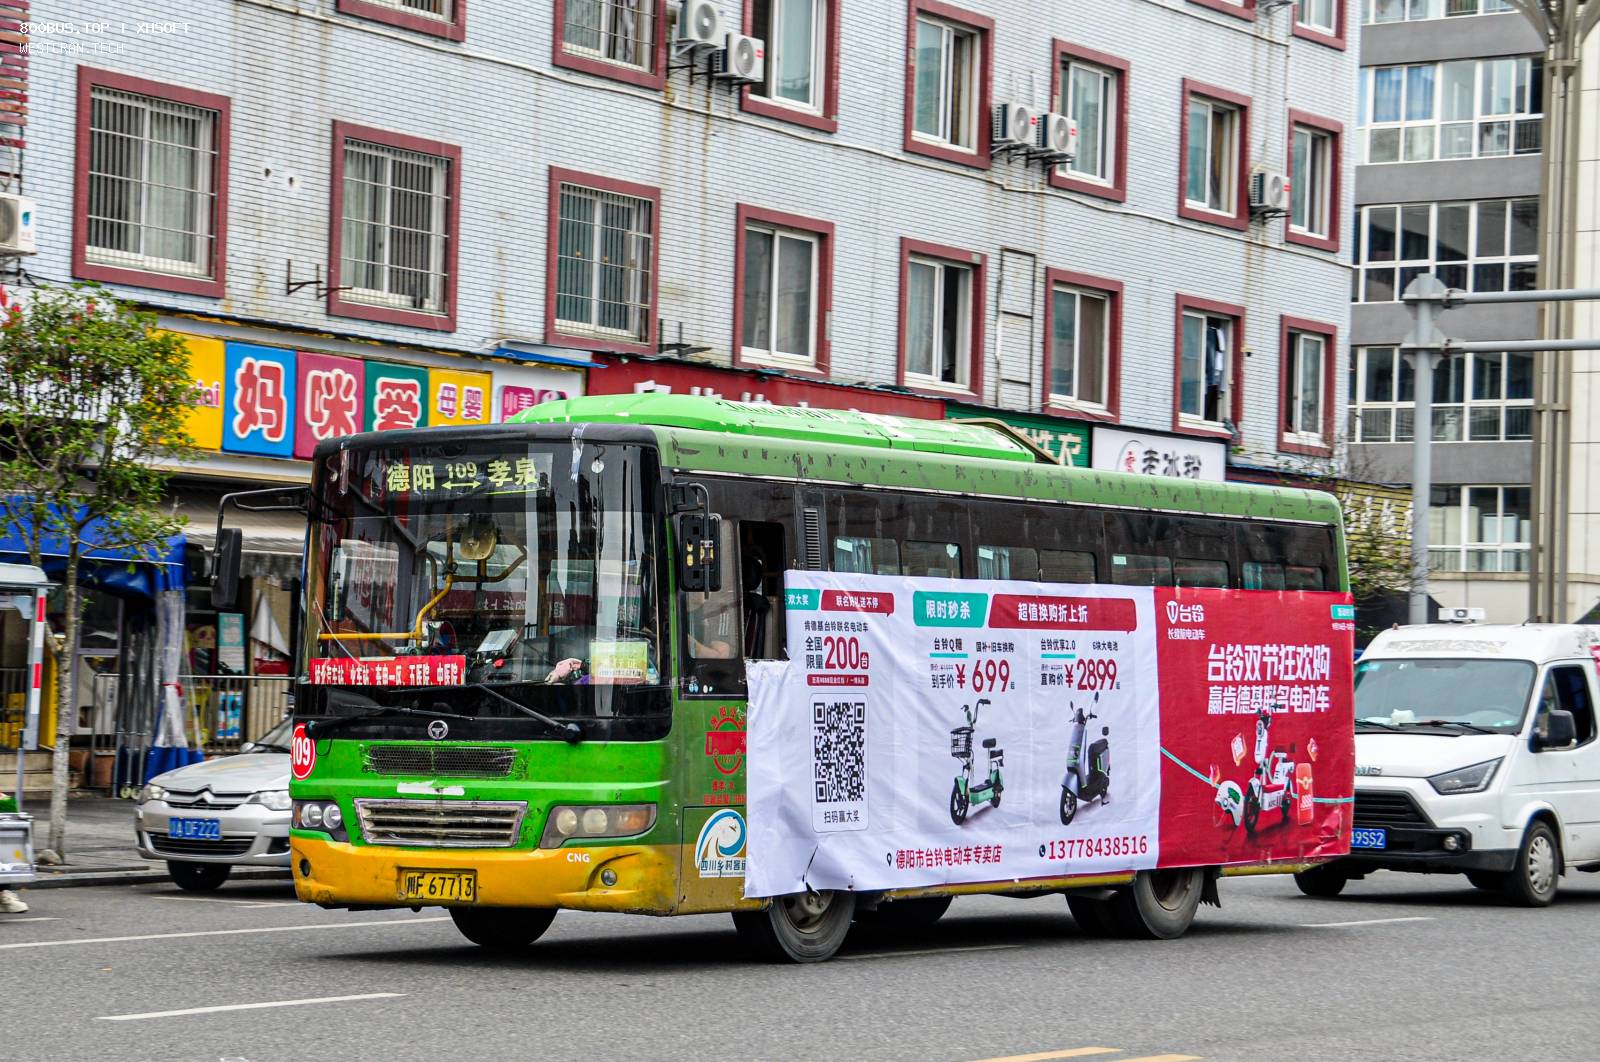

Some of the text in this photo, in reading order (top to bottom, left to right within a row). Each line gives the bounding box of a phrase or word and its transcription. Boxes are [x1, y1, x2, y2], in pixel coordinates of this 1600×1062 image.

[437, 383, 484, 421] 母婴
[387, 457, 538, 492] 德阳 109 孝泉
[784, 593, 809, 606] 欢大奖
[925, 600, 1089, 623] 限时秒杀 超值换购折上折
[1179, 603, 1205, 623] 台铃
[804, 620, 869, 633] 肯德基台铃联名电动车
[805, 636, 823, 652] 全国
[805, 654, 824, 670] 限量
[823, 635, 860, 670] 200
[1207, 643, 1331, 681] 台铃双节狂欢购
[931, 673, 954, 689] 到手价
[1040, 672, 1064, 686] 直购价
[1207, 684, 1331, 715] 赢肯德基联名电动车
[292, 735, 311, 767] 109
[823, 810, 860, 824] 扫码赢大奖
[566, 852, 590, 863] CNG
[895, 844, 1003, 870] 德阳市台铃电动车专卖店
[1048, 835, 1148, 860] 13778438516
